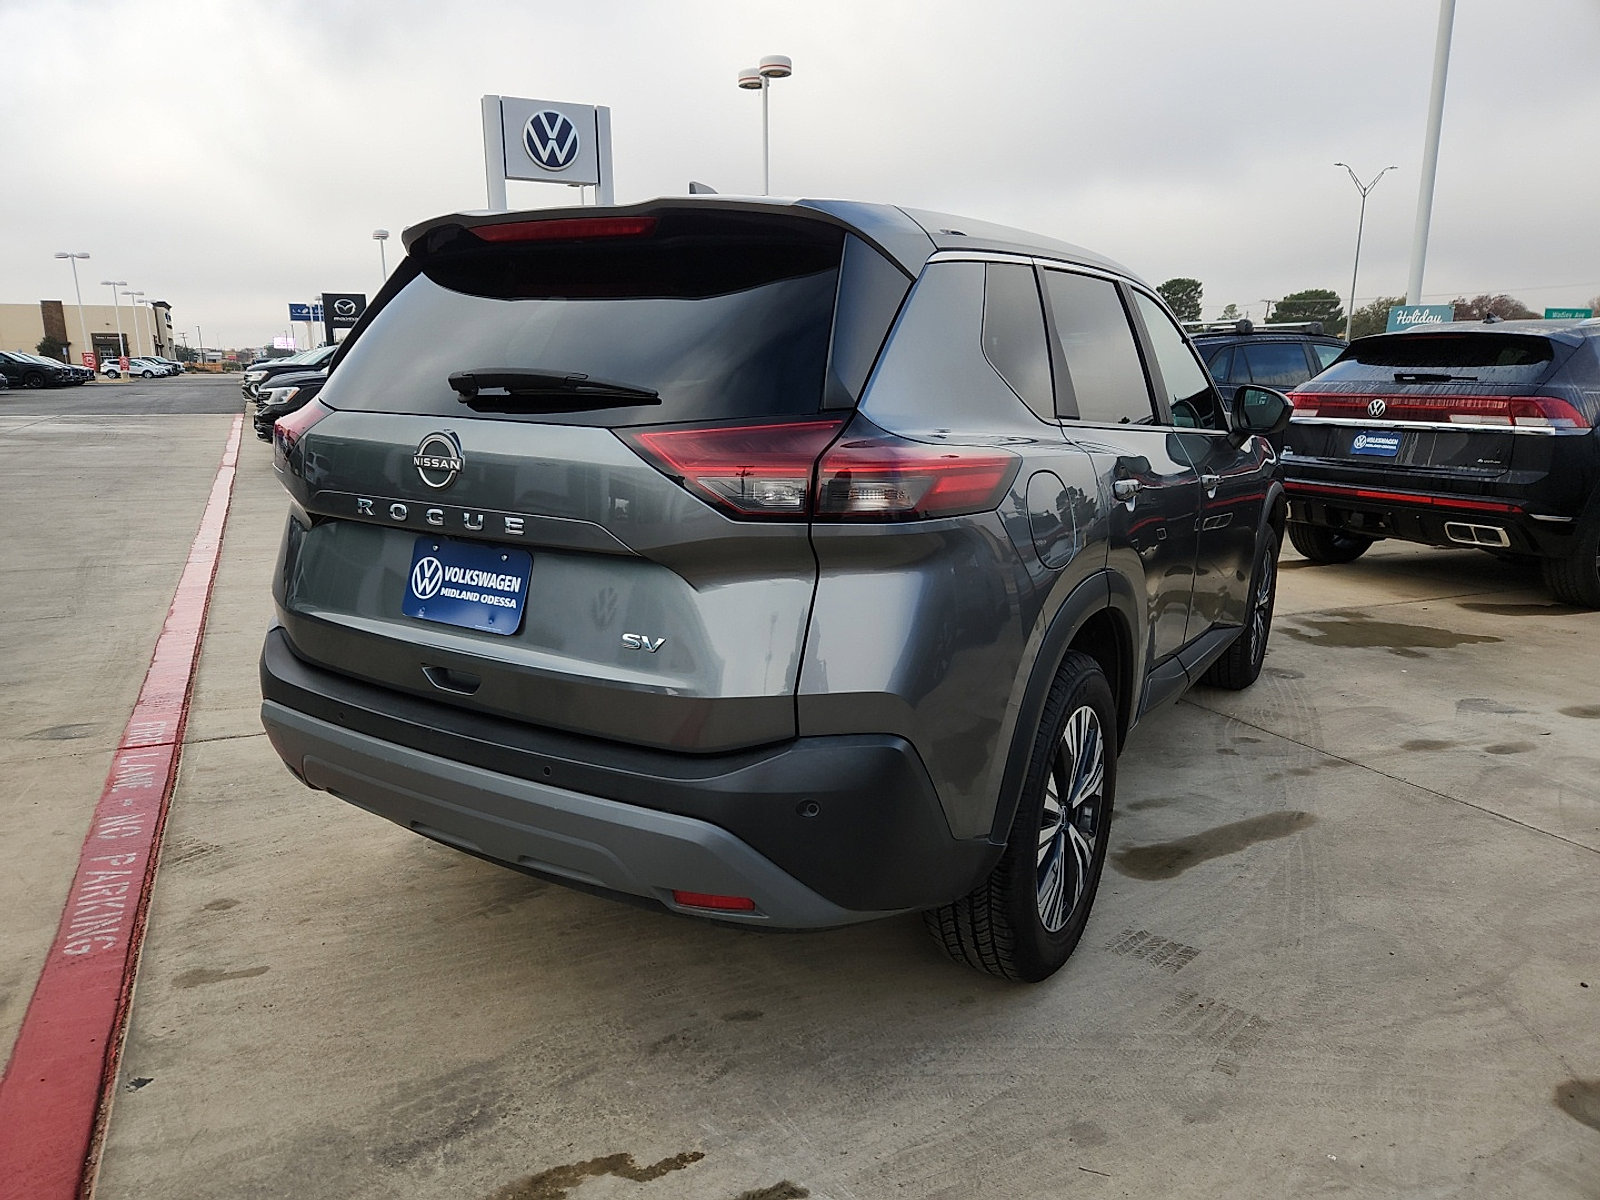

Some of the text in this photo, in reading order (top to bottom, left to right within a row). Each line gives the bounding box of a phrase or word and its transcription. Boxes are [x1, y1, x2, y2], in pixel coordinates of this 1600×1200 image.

[413, 456, 461, 470] NISSAN
[357, 498, 526, 536] ROGUE
[444, 565, 521, 593] VOLKSWAGEN
[440, 587, 517, 609] MIDLAND ODESSA
[622, 633, 666, 653] SV
[98, 813, 145, 840] NO
[63, 853, 137, 956] PARKING
